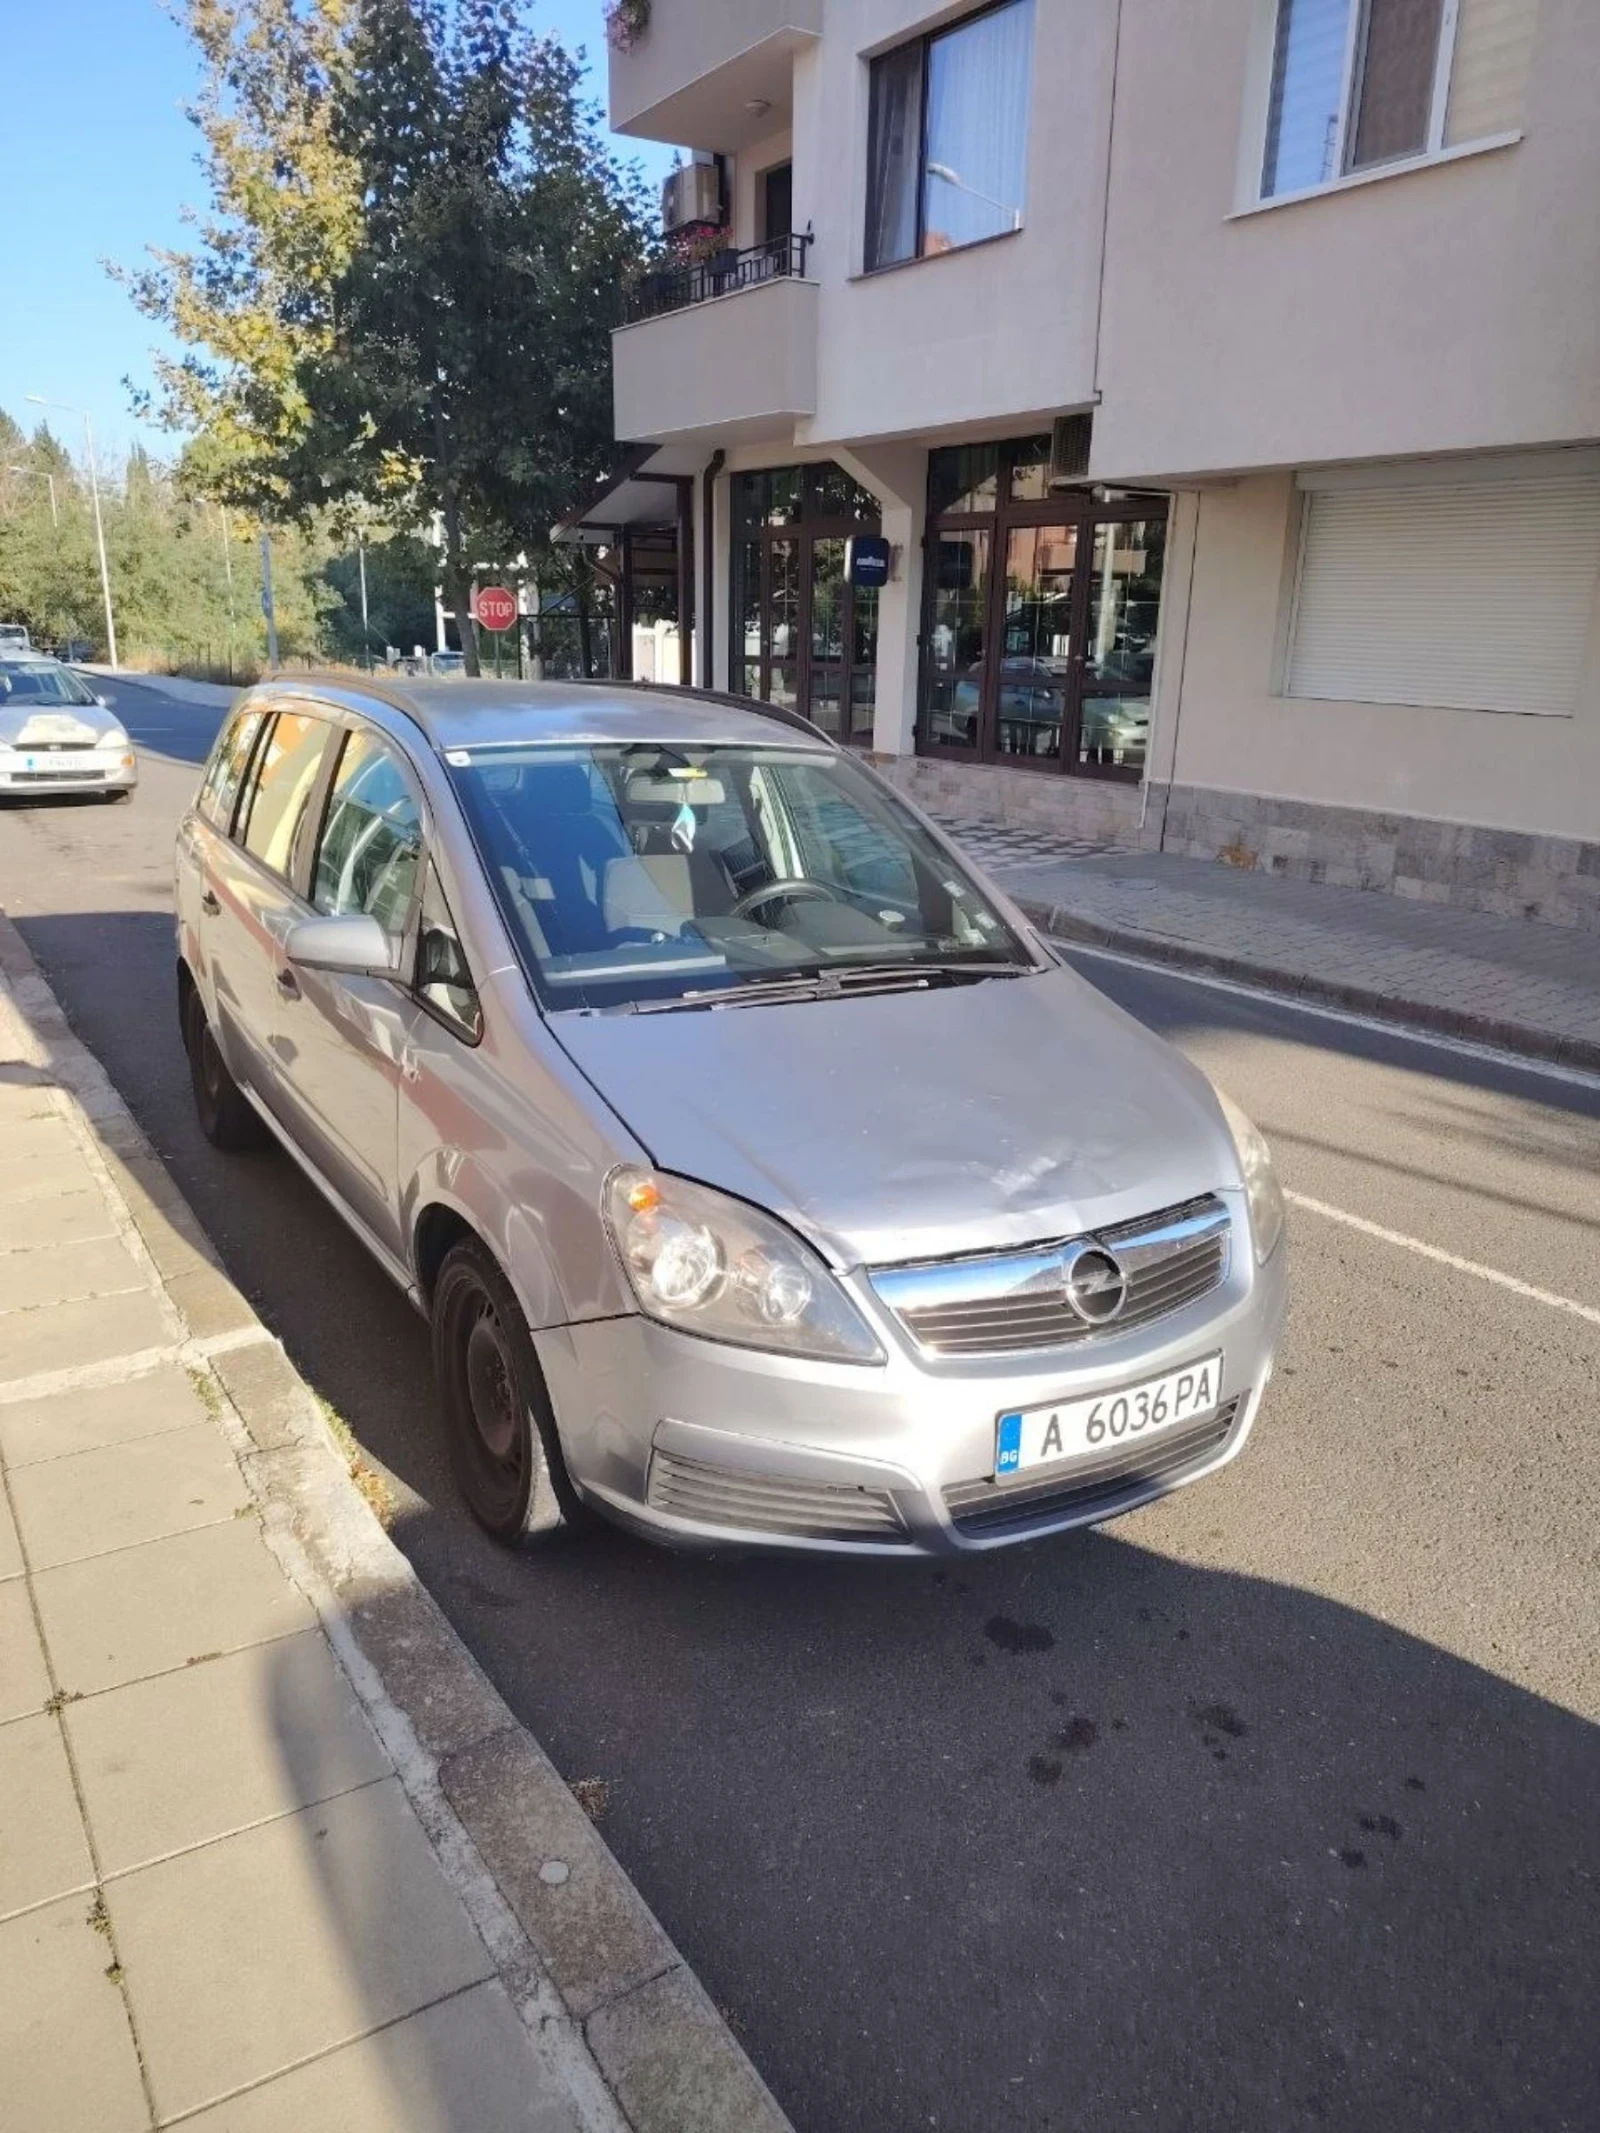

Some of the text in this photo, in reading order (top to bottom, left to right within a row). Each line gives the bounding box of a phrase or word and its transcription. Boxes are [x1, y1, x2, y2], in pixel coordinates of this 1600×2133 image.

[479, 601, 513, 618] STOP
[1040, 1412, 1064, 1457] A
[1000, 1450, 1018, 1464] BG
